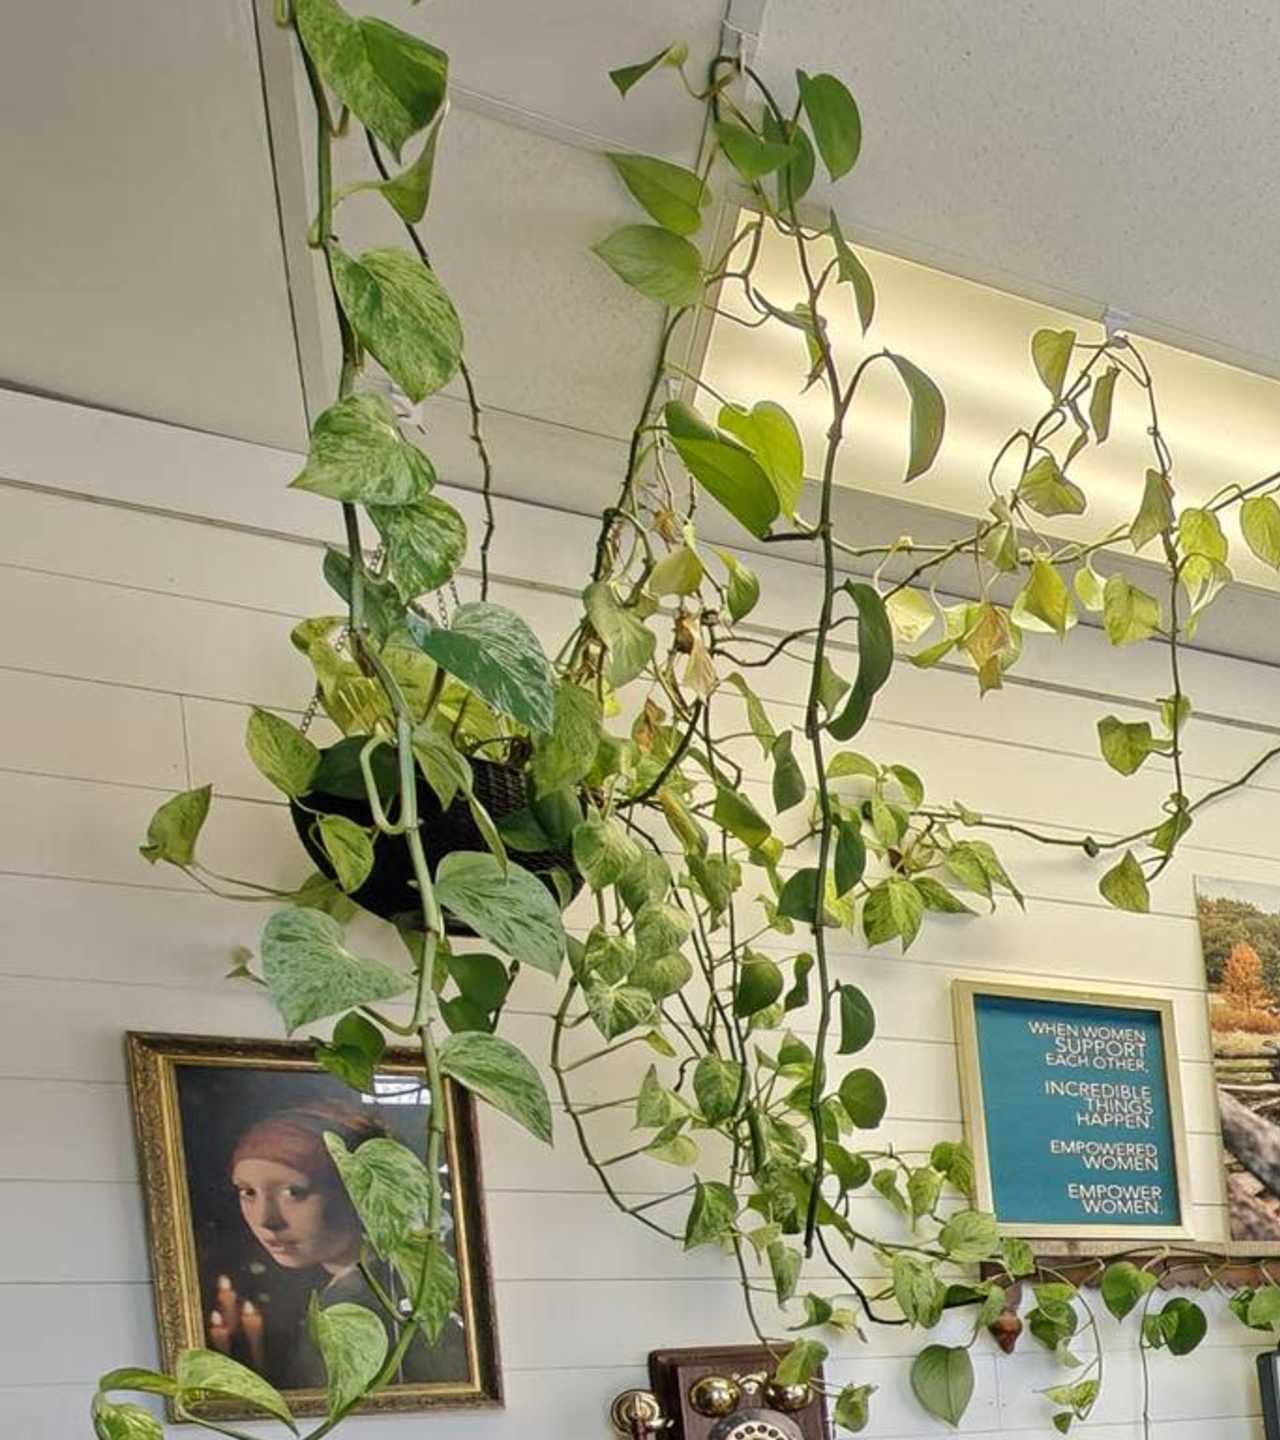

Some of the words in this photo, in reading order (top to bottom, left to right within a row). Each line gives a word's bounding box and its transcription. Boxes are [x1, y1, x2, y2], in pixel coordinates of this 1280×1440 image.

[1028, 1021, 1079, 1037] WHEN
[1082, 1026, 1146, 1041] WOMEN
[1055, 1037, 1146, 1057] SUPPORT
[1046, 1053, 1089, 1068] EACH
[1045, 1081, 1150, 1100] INCREDIBLE
[1088, 1099, 1153, 1114] THINGS
[1051, 1141, 1157, 1156] EMPOWERED
[1083, 1156, 1158, 1171] WOMEN
[1069, 1184, 1162, 1200] EMPOWER
